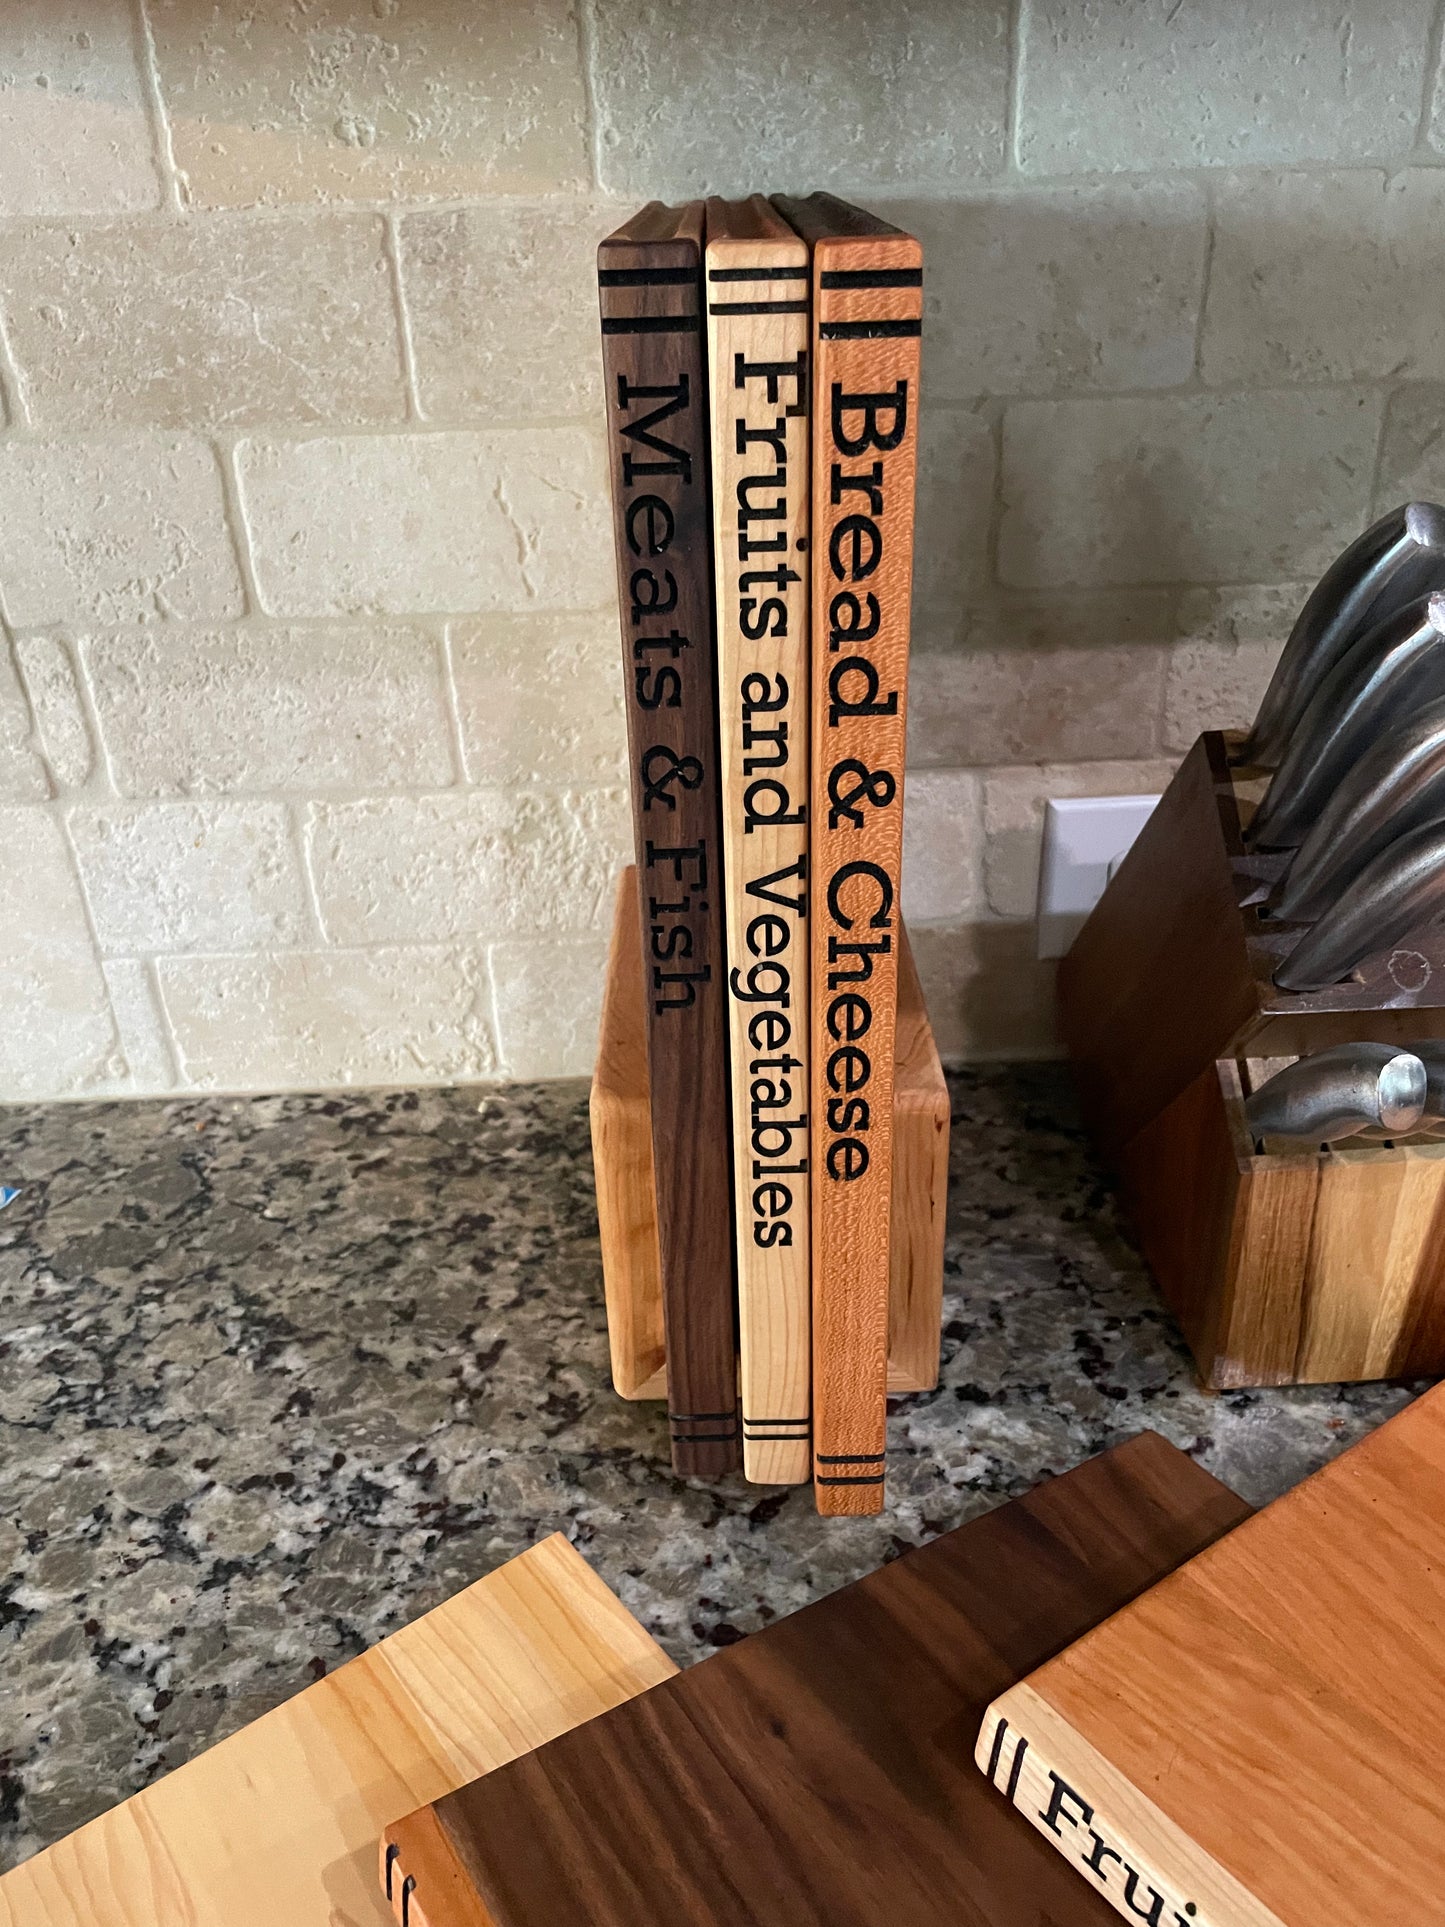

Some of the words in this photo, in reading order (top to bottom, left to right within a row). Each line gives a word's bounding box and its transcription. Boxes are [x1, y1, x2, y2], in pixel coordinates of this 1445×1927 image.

[617, 373, 693, 710] Meats
[734, 350, 808, 640] Fruits
[828, 379, 908, 728] Bread
[641, 745, 704, 812] &
[740, 671, 807, 834] and
[827, 758, 896, 830] &
[645, 839, 712, 1016] Fish
[730, 853, 809, 1249] Vegetables
[826, 860, 894, 1182] Cheese
